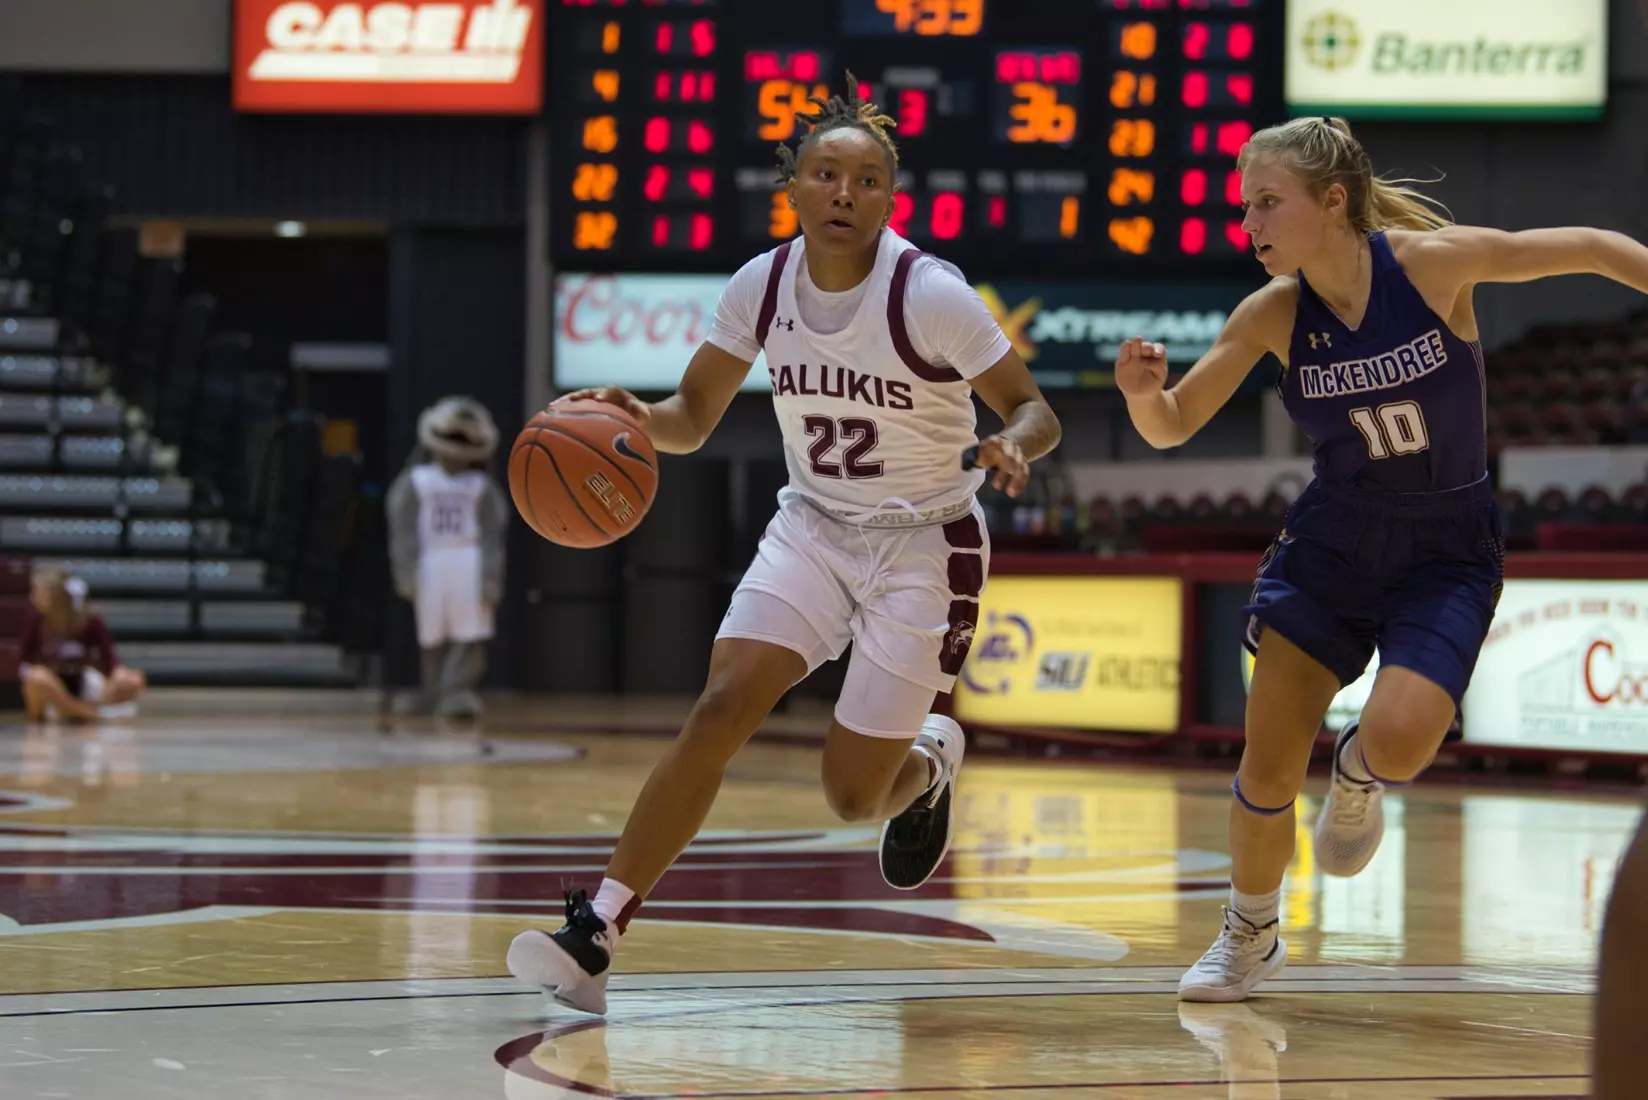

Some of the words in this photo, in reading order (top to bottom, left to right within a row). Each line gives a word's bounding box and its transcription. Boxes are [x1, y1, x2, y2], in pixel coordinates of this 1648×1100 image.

[265, 1, 463, 50] CASE
[1371, 31, 1587, 76] Banterra
[898, 89, 928, 135] 3
[1007, 81, 1076, 142] 36
[1300, 329, 1448, 399] McKENDREE
[802, 414, 884, 479] 22
[1349, 400, 1430, 459] 10
